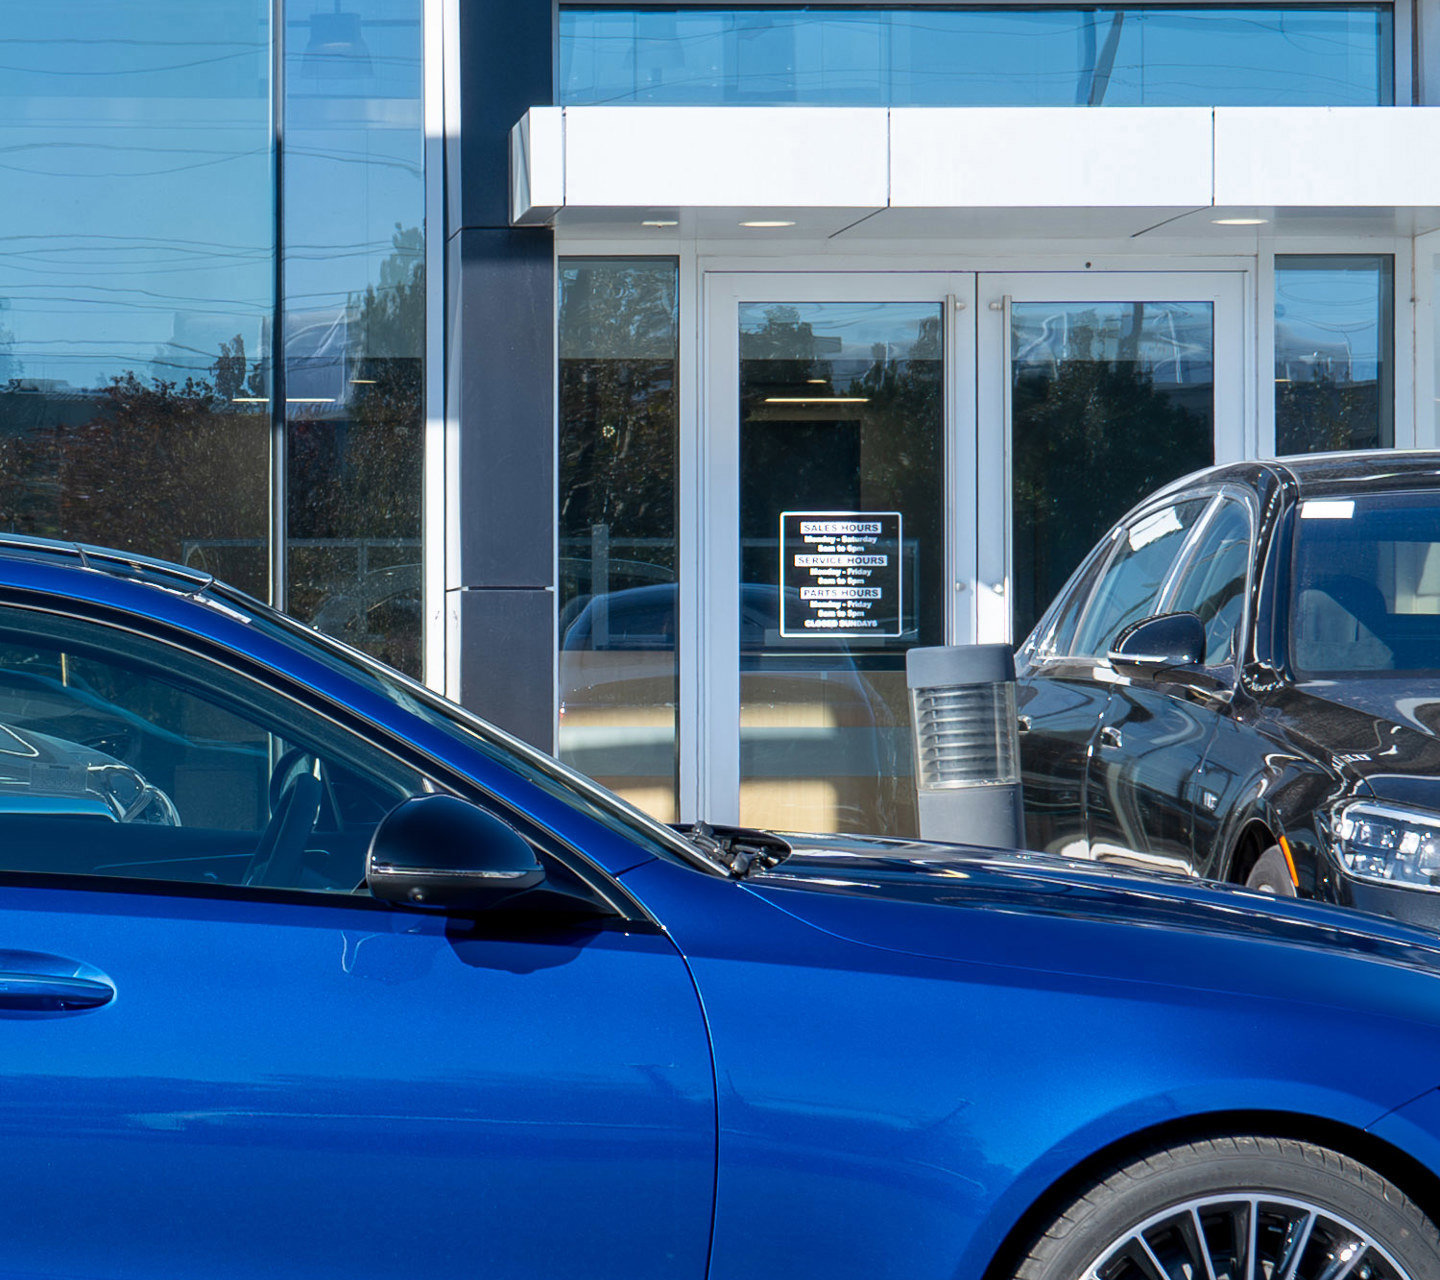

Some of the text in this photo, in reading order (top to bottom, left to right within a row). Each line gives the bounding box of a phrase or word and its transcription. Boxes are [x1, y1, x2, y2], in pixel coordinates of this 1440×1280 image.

[804, 524, 879, 532] SALES HOURS
[841, 535, 878, 544] Saturday
[847, 568, 872, 577] Friday
[804, 589, 879, 597] PARTS HOURS
[847, 600, 872, 609] Friday
[839, 619, 878, 628] SUNDAYS
